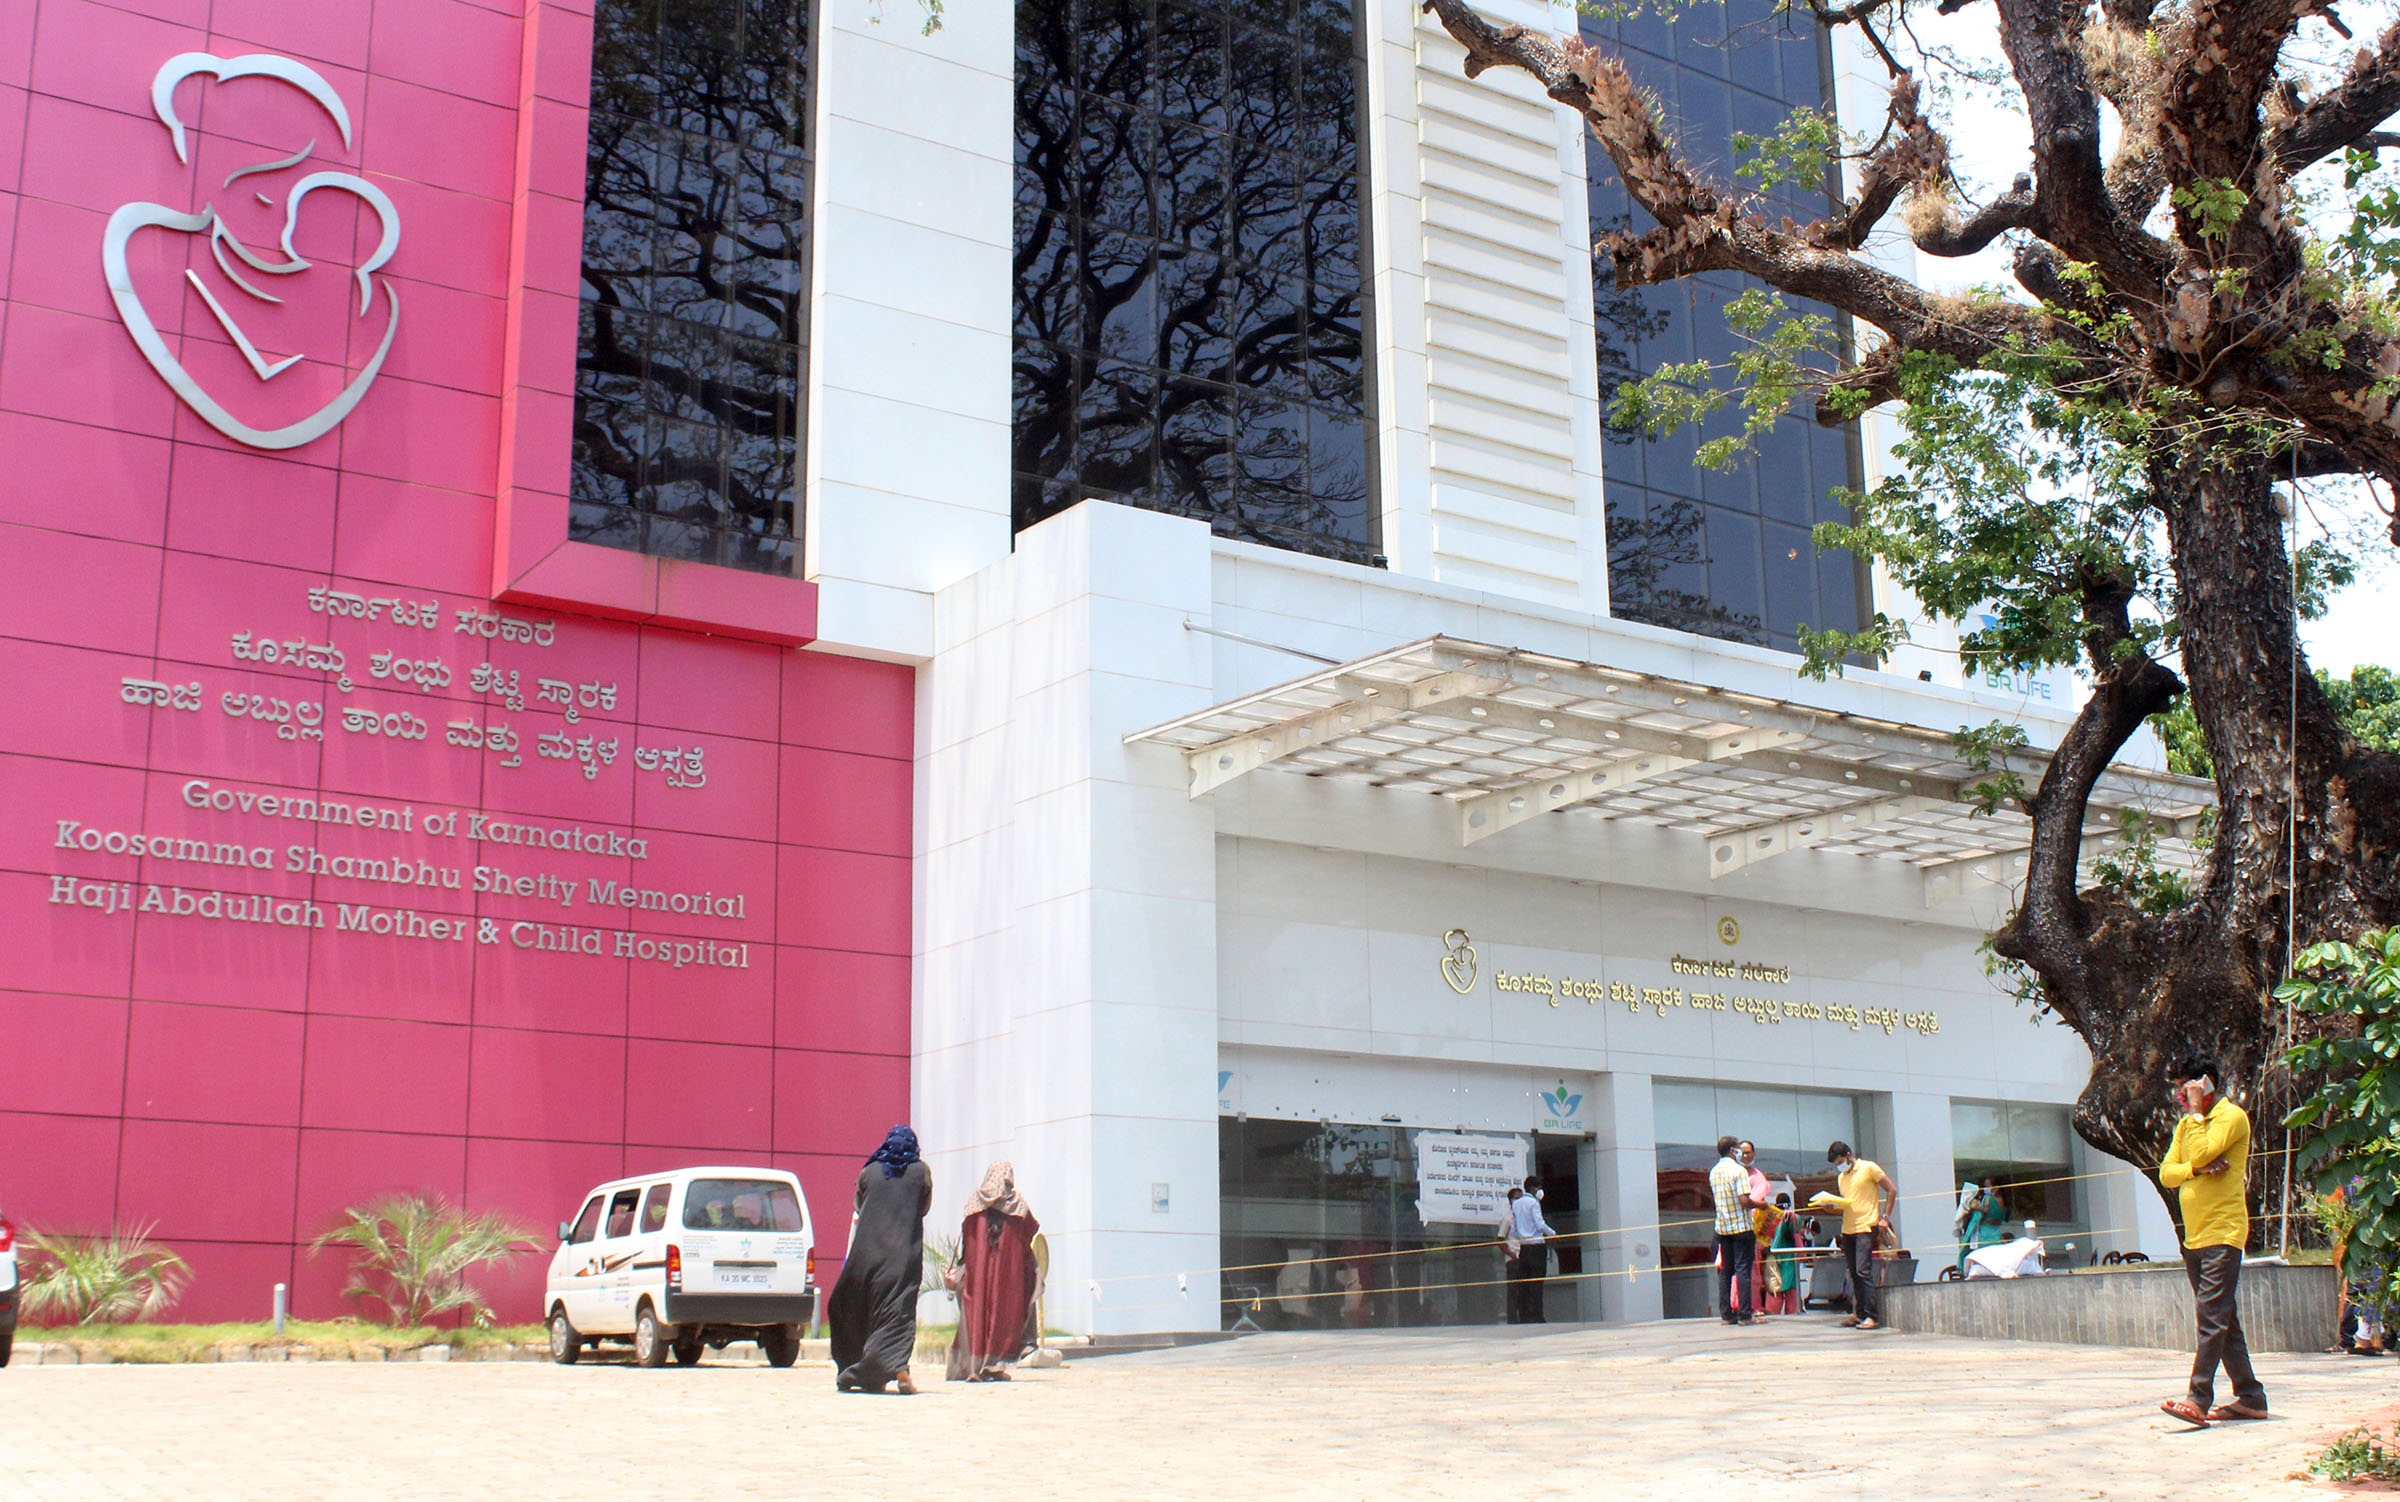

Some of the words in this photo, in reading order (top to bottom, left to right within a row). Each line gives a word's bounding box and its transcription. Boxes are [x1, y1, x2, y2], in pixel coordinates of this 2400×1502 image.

[307, 583, 439, 629] ಕರ್ನಾಟಕ
[454, 606, 556, 646] ಸರಕಾರ
[231, 629, 355, 693] ಕೂಸಮ್ಮ
[368, 649, 452, 693] ಶಂಭು
[470, 661, 525, 712] ಶೆಟ್ಟಿ
[536, 677, 618, 724] ಸ್ಮಾರಕ
[1986, 671, 2012, 692] BR
[2016, 676, 2052, 700] LIFE
[120, 677, 203, 712] ಹಾಜಿ
[221, 691, 325, 742] ಅಬ್ದುಲ್ಲ
[342, 707, 428, 741] ತಾಯಿ
[445, 717, 523, 768] ಮತ್ತು
[537, 729, 619, 781] ಮಕ್ಕಳ
[634, 745, 707, 788] ಆಸ್ಪತ್ರೆ
[182, 780, 414, 832] Government
[423, 811, 458, 838] of
[466, 814, 649, 860] Karnataka
[54, 820, 274, 871] Koosamma
[284, 845, 462, 890] Shambhu
[472, 865, 578, 907] Shetty
[587, 878, 747, 920] Memorial
[49, 875, 132, 915] Haji
[138, 884, 326, 928] Abdullah
[336, 903, 467, 942] Mother
[476, 918, 500, 945] &
[510, 921, 603, 955] Child
[613, 931, 749, 969] Hospital
[1495, 969, 1559, 1008] ಕೂಸಮ್ಮ
[1560, 976, 1604, 1005] ಶಂಭು
[1689, 991, 1726, 1012] ಹಾಜಿ
[1782, 1000, 1821, 1021] ತಾಯಿ
